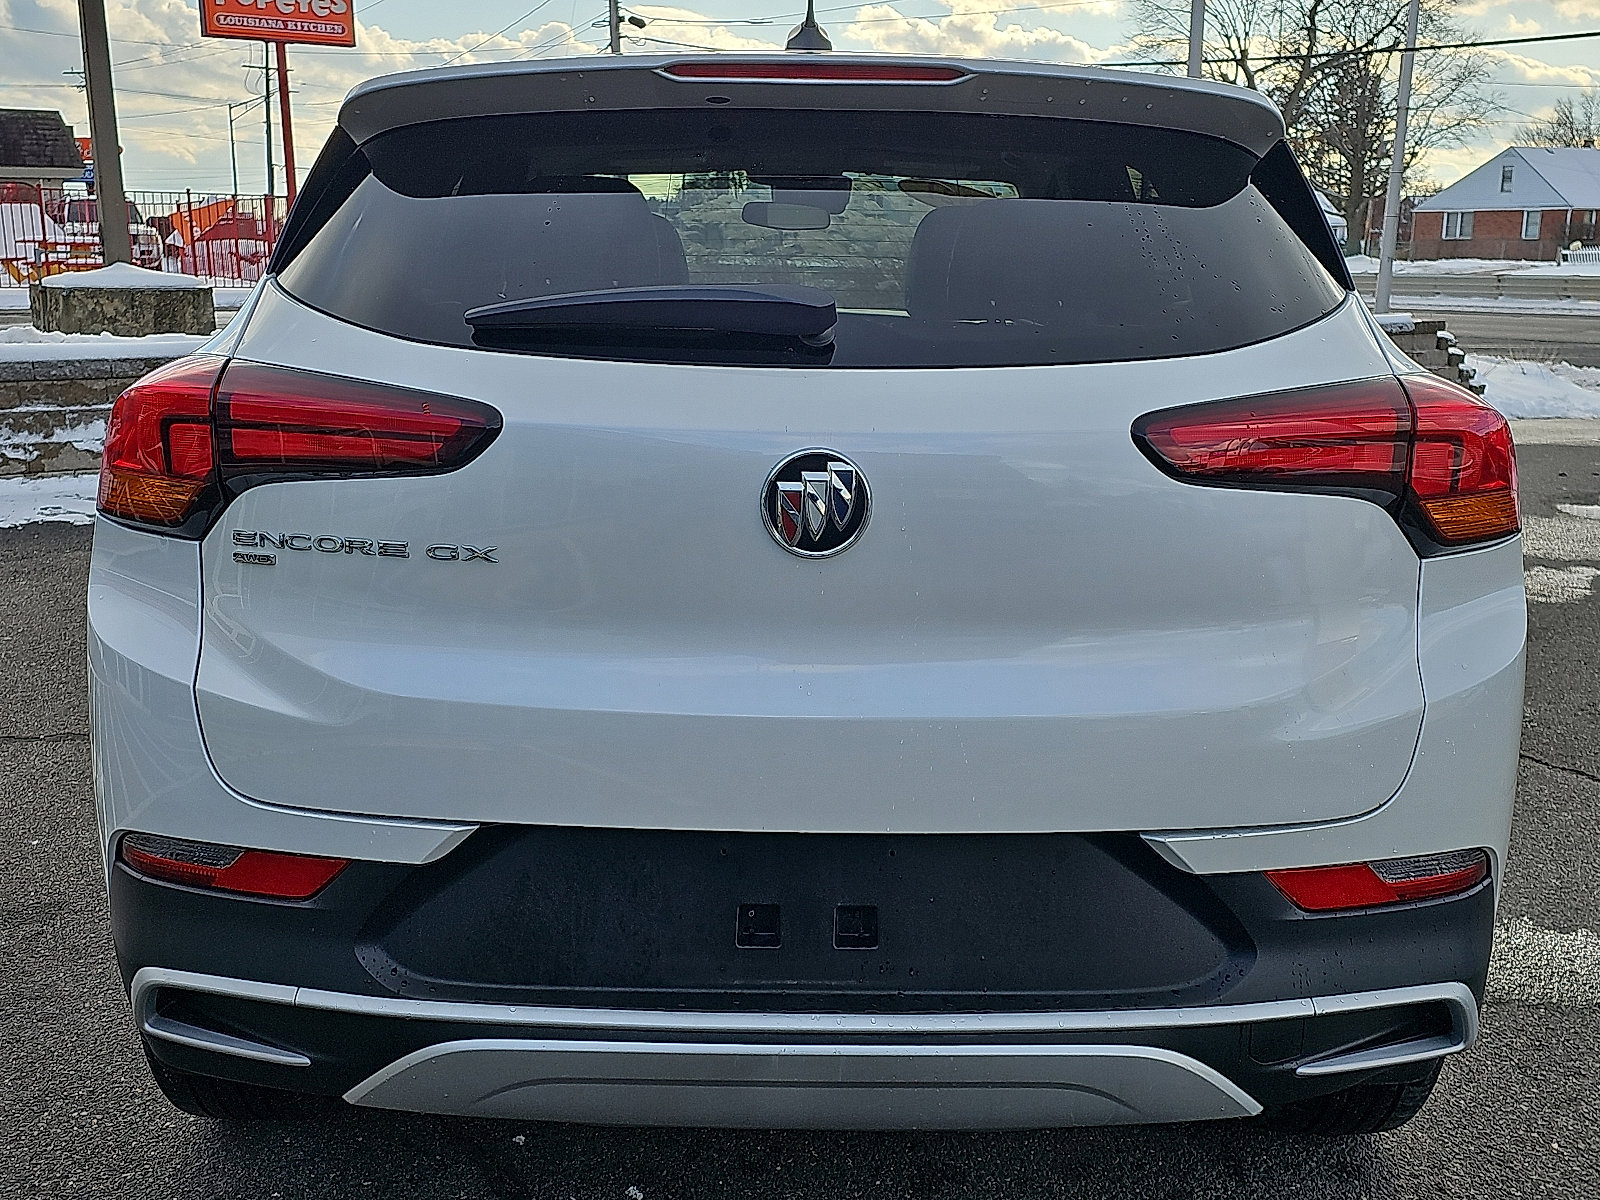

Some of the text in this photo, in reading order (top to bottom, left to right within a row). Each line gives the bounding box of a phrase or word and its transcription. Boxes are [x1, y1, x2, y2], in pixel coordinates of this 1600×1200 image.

[218, 15, 343, 34] LOUISIANA KITCHEN
[232, 529, 499, 563] ENCORE GX
[232, 551, 276, 565] AWD
